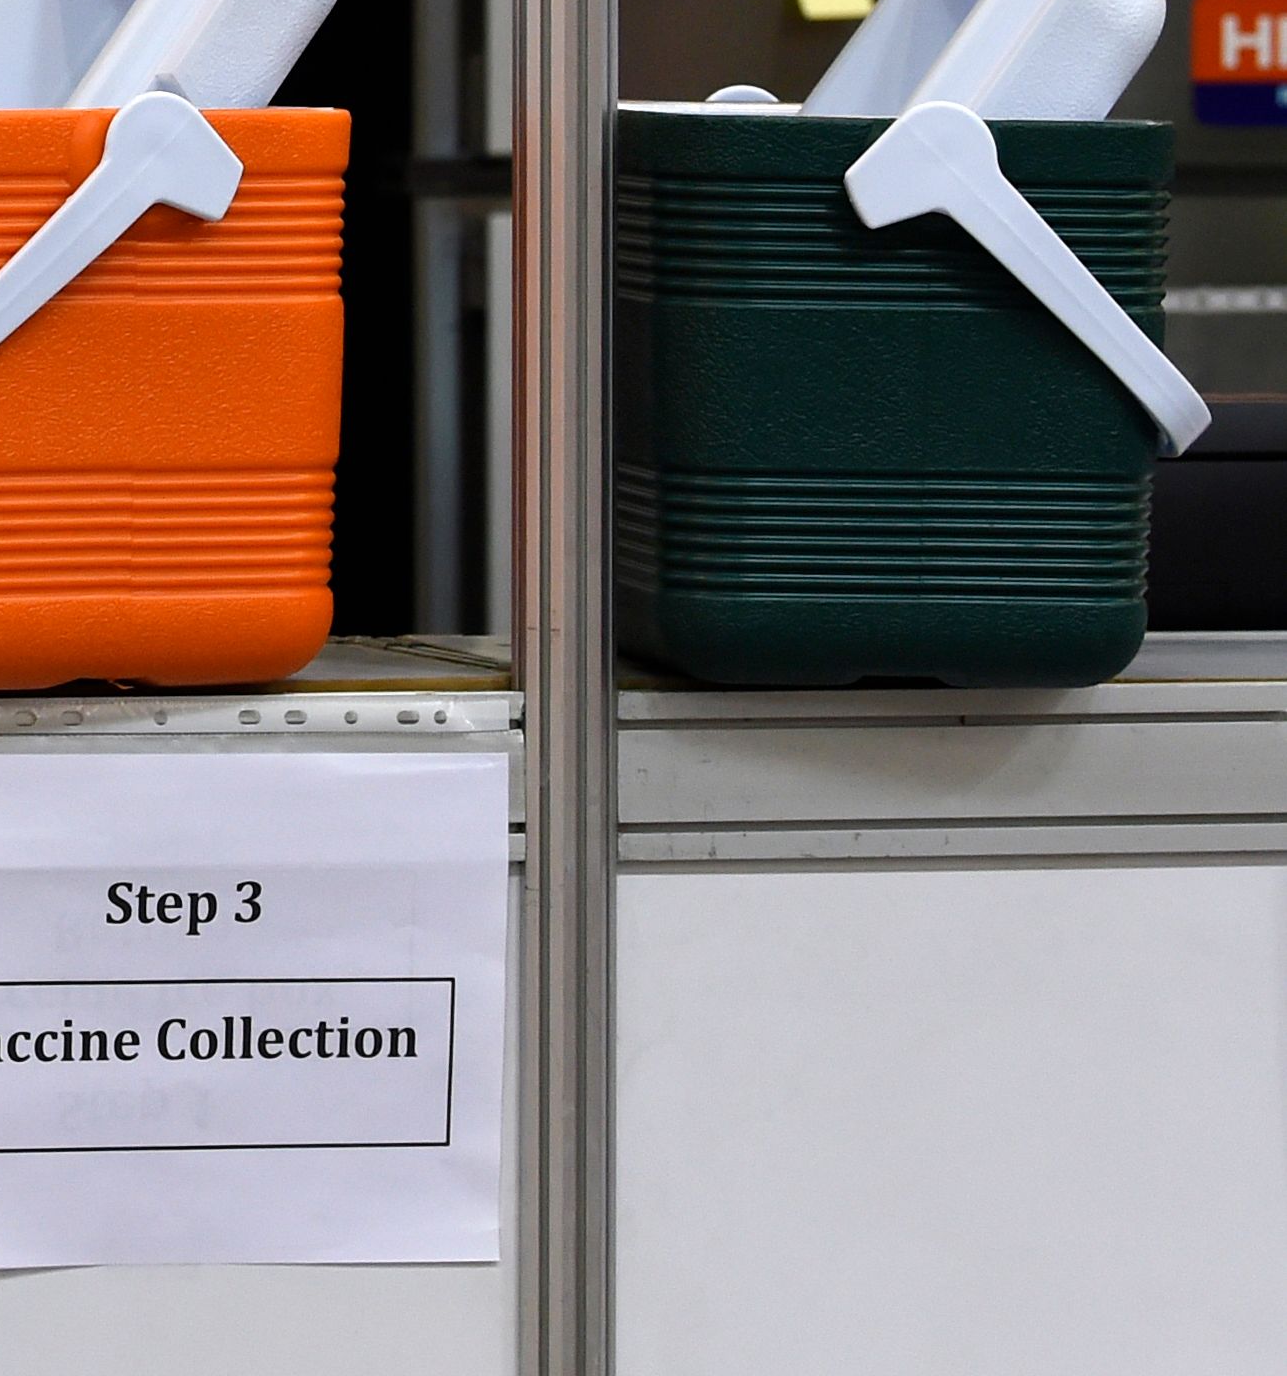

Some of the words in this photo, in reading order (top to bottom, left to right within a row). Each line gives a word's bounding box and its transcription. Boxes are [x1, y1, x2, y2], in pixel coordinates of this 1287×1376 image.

[105, 881, 219, 936] Step
[233, 880, 263, 924] 3
[156, 1015, 419, 1062] Collection
